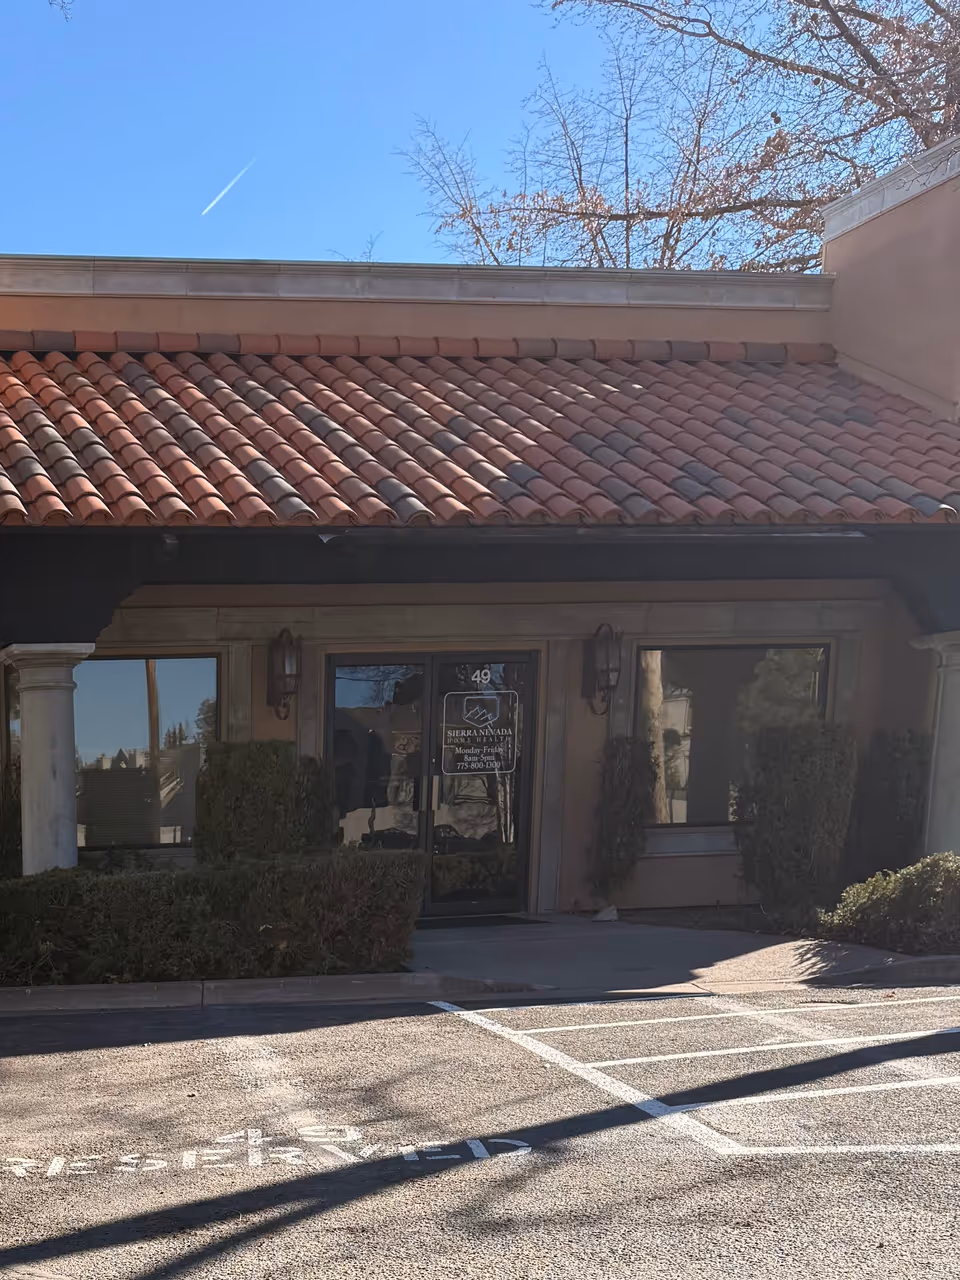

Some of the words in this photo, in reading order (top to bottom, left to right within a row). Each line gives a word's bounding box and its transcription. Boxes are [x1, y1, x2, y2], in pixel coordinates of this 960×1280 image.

[471, 669, 491, 684] 49
[447, 729, 477, 737] SIERRA
[479, 728, 512, 736] NEVADA
[214, 1124, 364, 1147] 49
